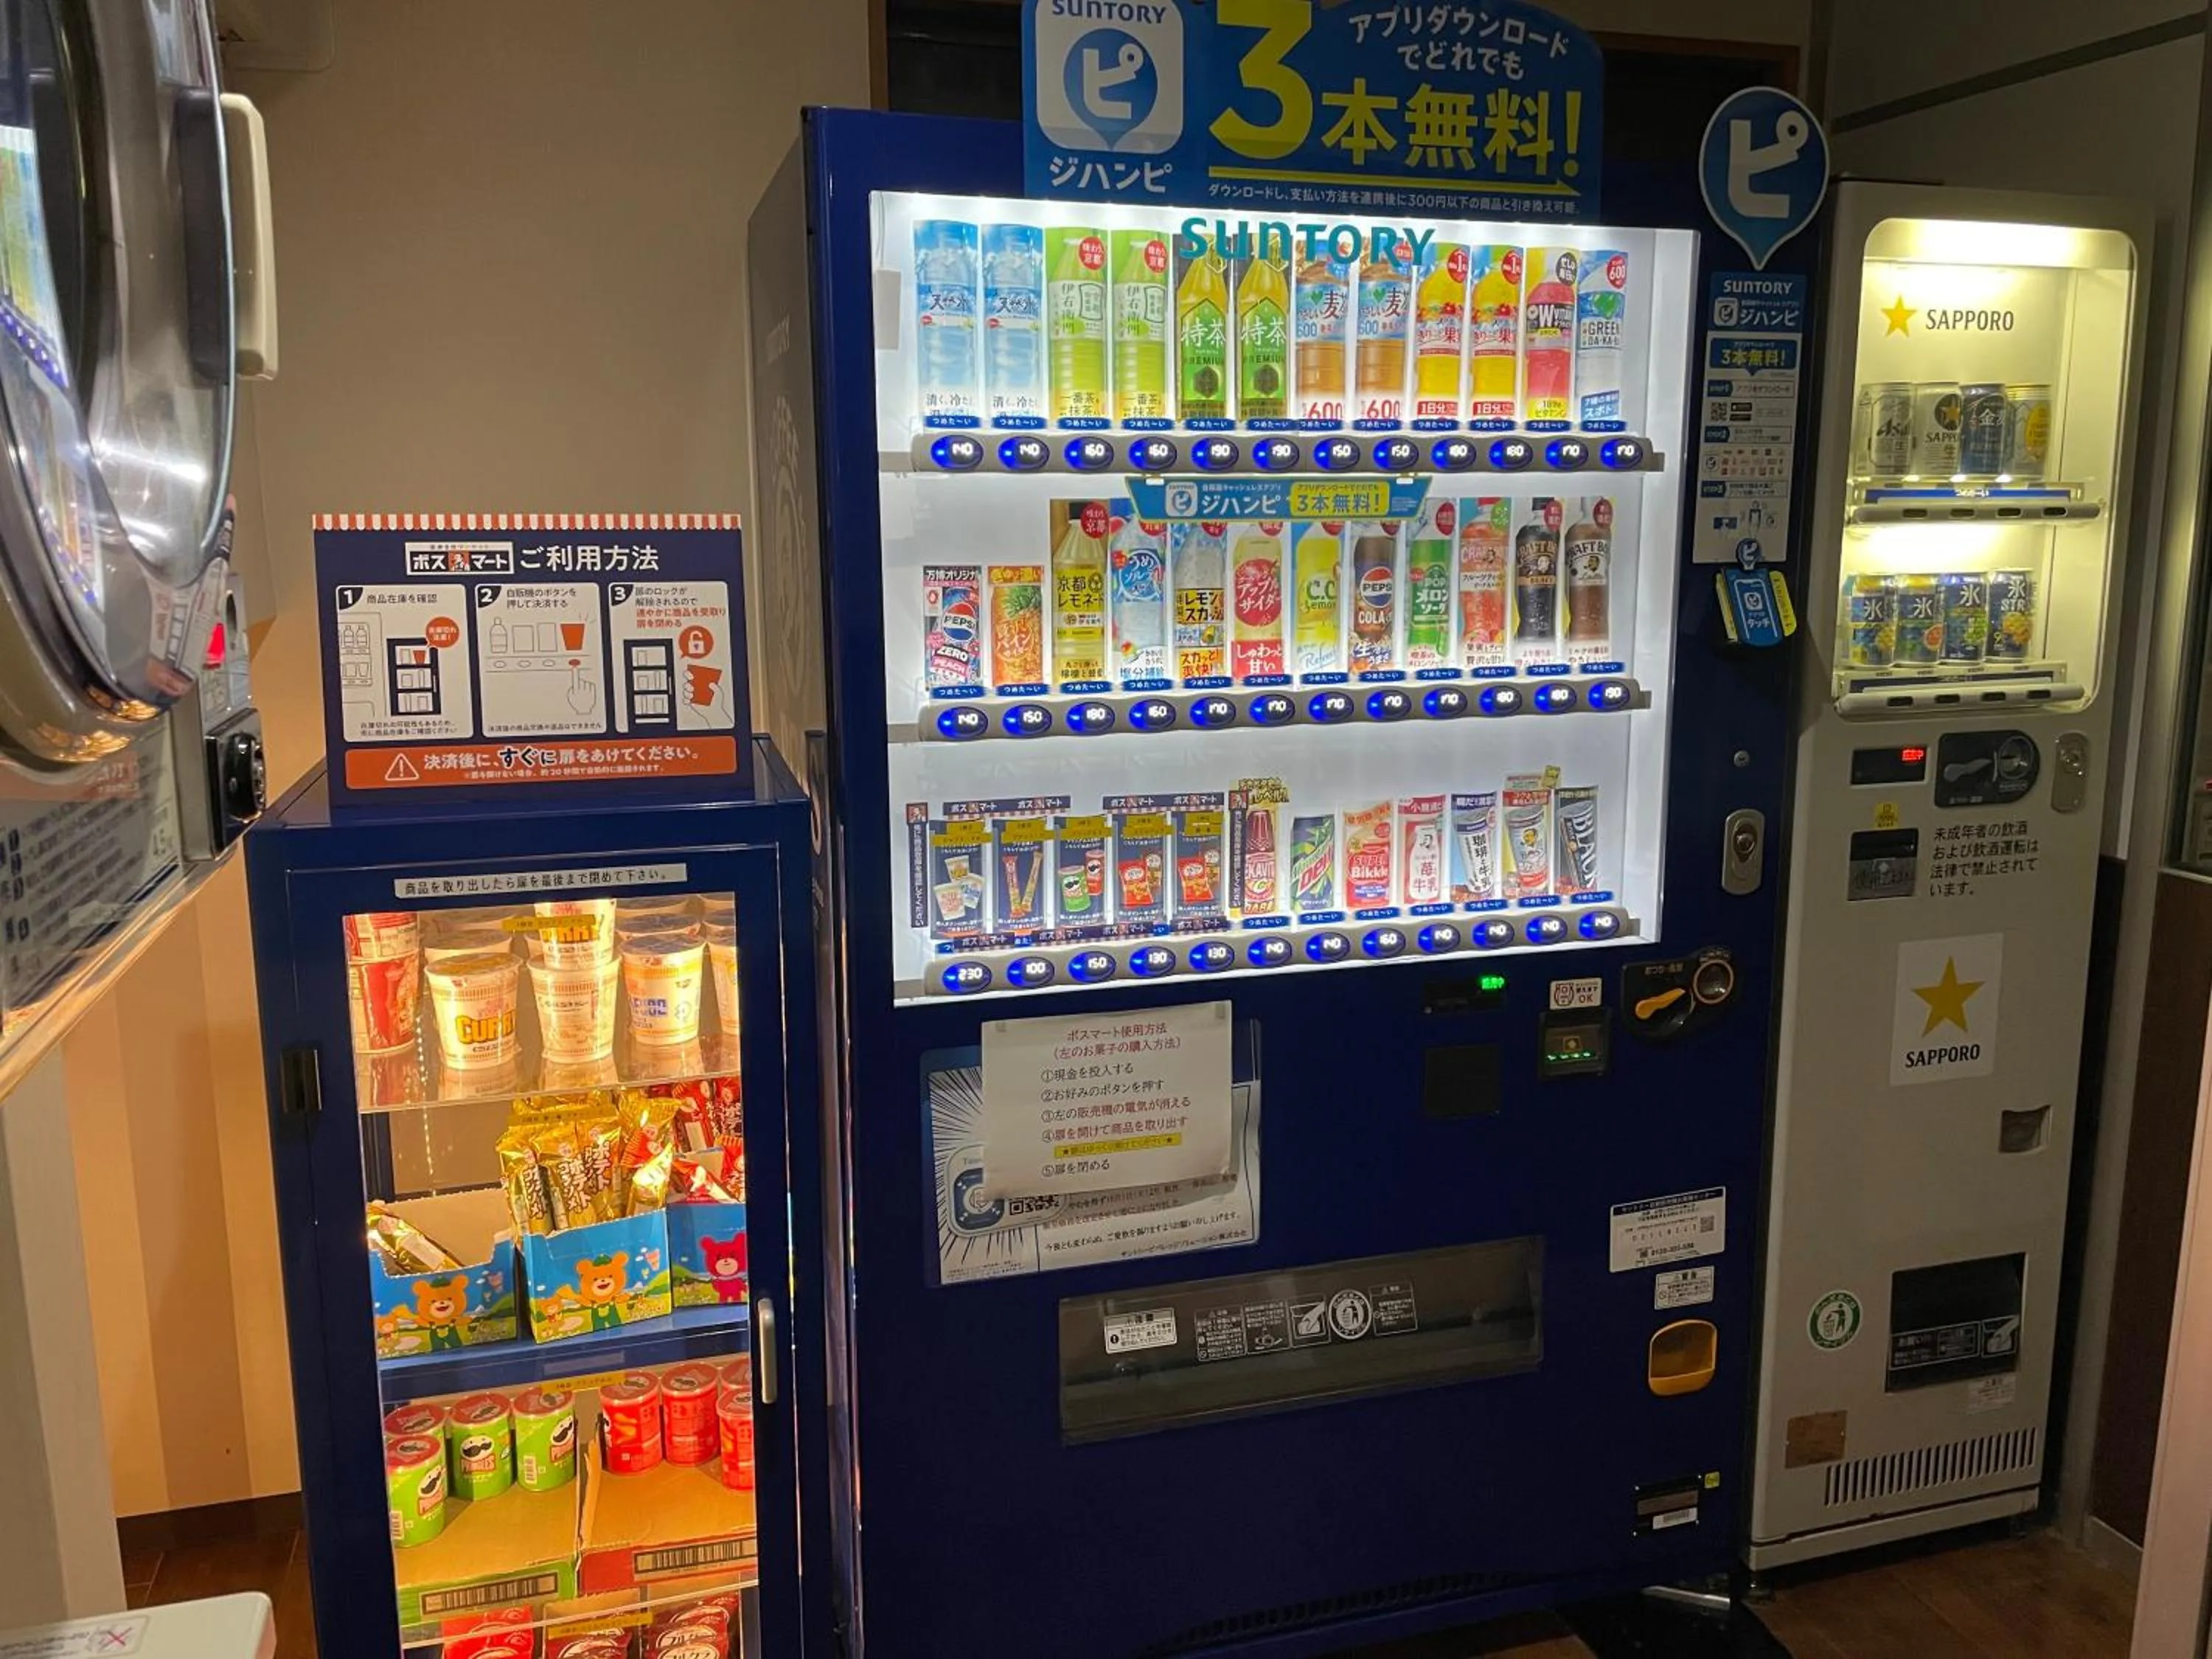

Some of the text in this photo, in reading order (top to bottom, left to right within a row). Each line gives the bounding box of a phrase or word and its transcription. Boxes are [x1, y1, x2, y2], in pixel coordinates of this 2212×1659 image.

[1051, 0, 1166, 24] SUNTORY
[1349, 5, 1569, 58] アプリダウンロード
[1397, 41, 1526, 81] でどれでも
[1049, 156, 1173, 194] ジハンピ
[1180, 218, 1435, 267] SUNTORY
[1723, 279, 1792, 295] SUNTORY
[1740, 309, 1799, 326] ジハンピ
[1926, 308, 2014, 332] SAPPORO
[1180, 317, 1226, 347] 特茶
[1241, 316, 1287, 347] 特茶
[1201, 495, 1281, 515] ジハンピ
[519, 545, 660, 572] ご利用方法
[507, 587, 577, 599] 自販機のボタンを
[1059, 575, 1086, 591] 京都
[1363, 582, 1393, 592] PEPS
[344, 591, 353, 605] 1
[366, 593, 437, 605] 商品在庫を確認
[481, 589, 494, 603] 2
[507, 598, 568, 609] 押して決済する
[614, 586, 627, 601] 3
[635, 597, 699, 607] 解除されるので
[1185, 591, 1217, 605] レモン
[1358, 611, 1385, 625] COLA
[936, 646, 970, 662] ZERO
[1249, 661, 1276, 674] 甘い
[424, 745, 699, 771] 決済後に、すぐに扉をあけてください。
[1934, 821, 2028, 841] 未成年者の飲酒
[1933, 839, 2039, 860] および飲酒運転は
[1930, 858, 2039, 880] 法律で禁止されて
[404, 869, 667, 896] 商品を取り出したら扉を最後まで閉めて下さい。
[1929, 882, 1975, 897] います。
[1579, 994, 1593, 1004] OK
[1068, 1023, 1169, 1043] ボスマート使用方法
[1905, 1043, 1980, 1068] SAPPORO
[1040, 1062, 1134, 1083] ①現金を投入する
[1040, 1079, 1165, 1103] ②お好みのボタンを押す
[1041, 1116, 1189, 1143] ④扉を開けて商品を取り出す
[1041, 1159, 1111, 1178] ⑤扉を閉める
